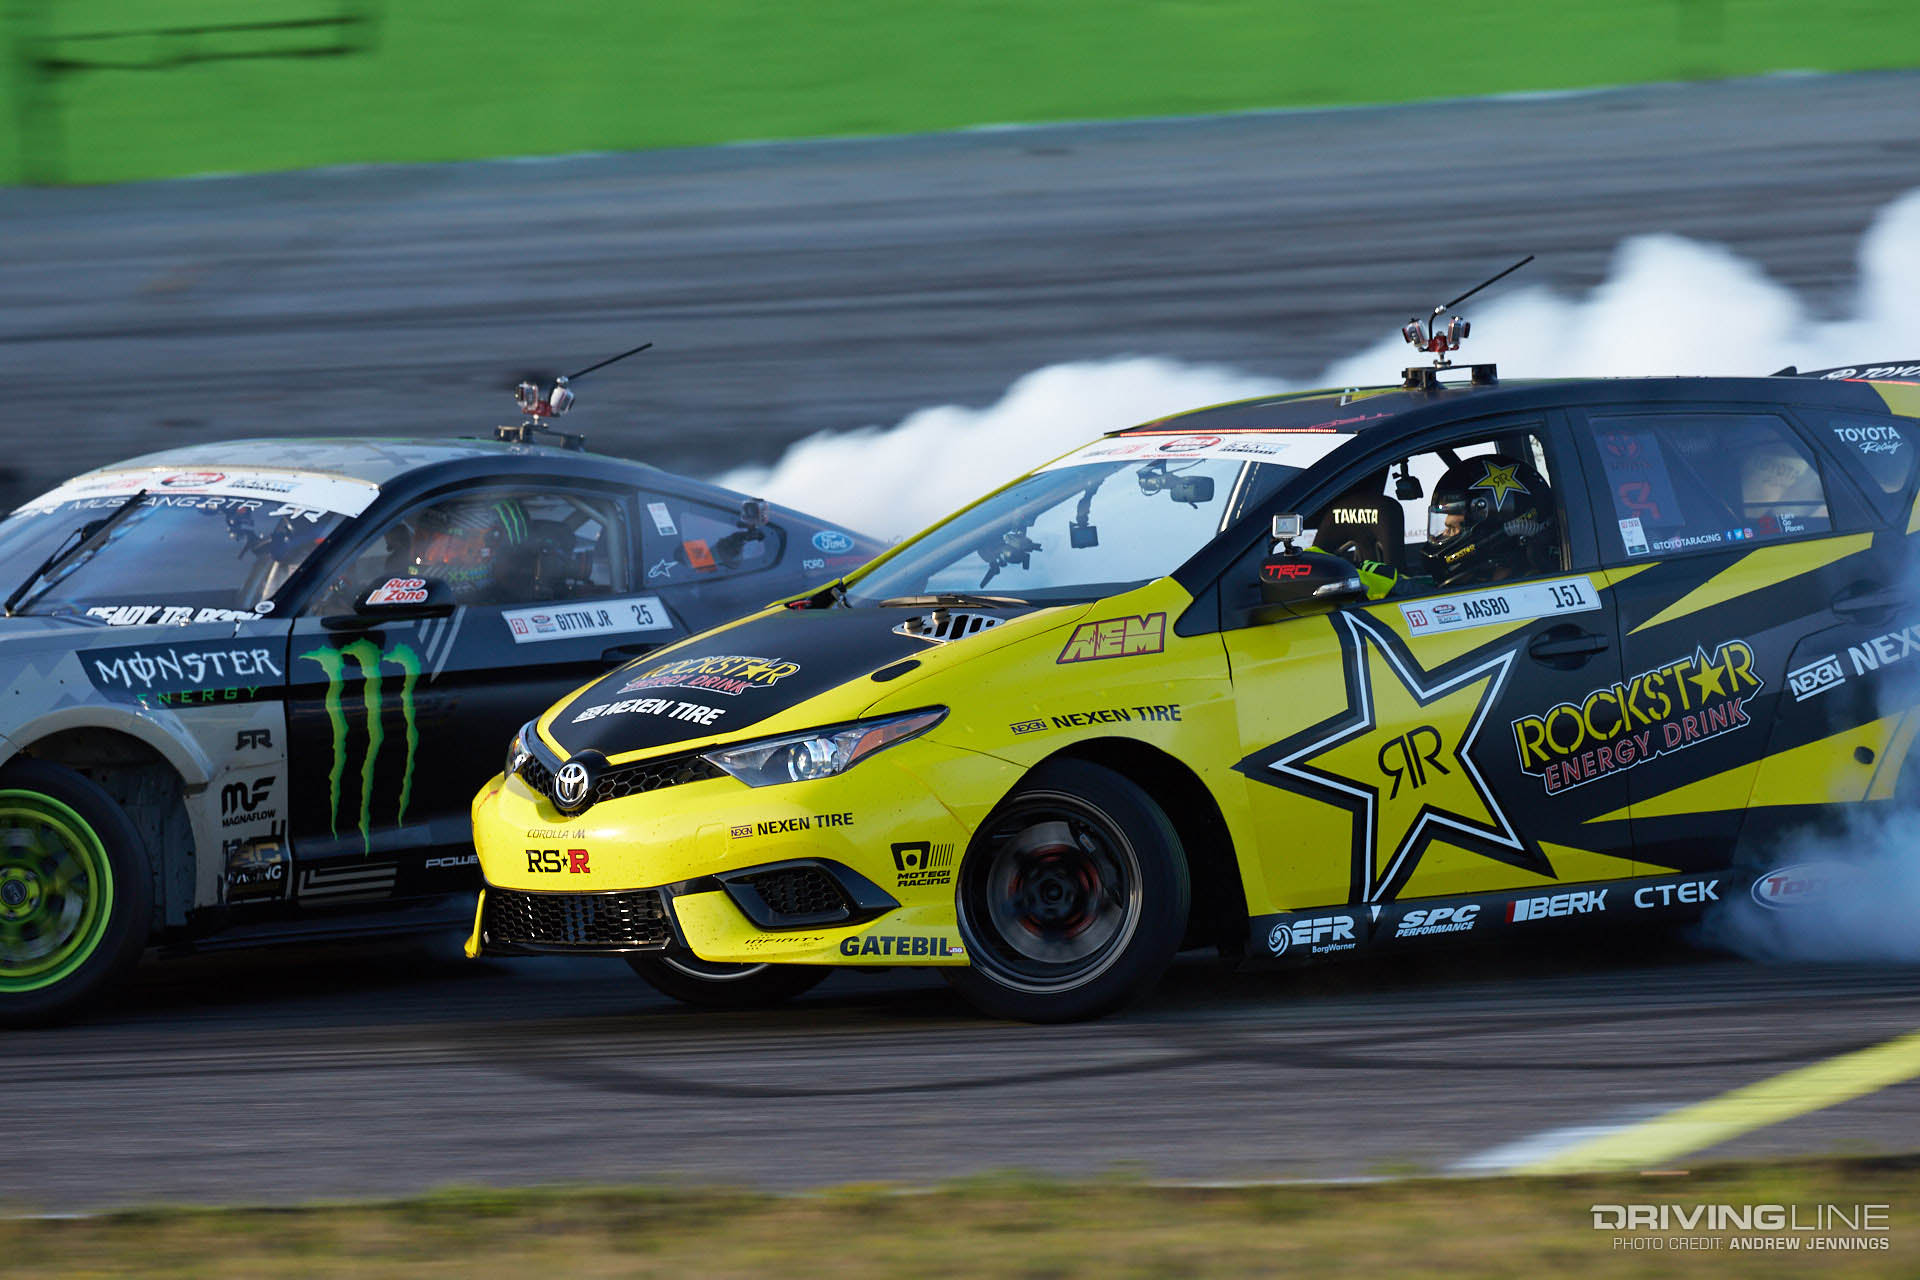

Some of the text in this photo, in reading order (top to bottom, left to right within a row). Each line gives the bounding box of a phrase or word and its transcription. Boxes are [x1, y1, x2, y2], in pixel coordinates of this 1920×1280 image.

[1833, 426, 1901, 442] TOYOTA
[1859, 440, 1903, 454] Racing
[1333, 508, 1379, 524] TAKATA
[1653, 533, 1722, 551] @TOYOTARACING
[802, 558, 825, 569] FORD
[1264, 564, 1313, 580] TRD
[385, 578, 425, 590] Auto
[384, 589, 426, 602] Zone
[1463, 596, 1510, 620] AASBO
[1549, 584, 1586, 609] 151
[555, 611, 595, 631] GITTIN
[597, 609, 613, 627] JR
[631, 604, 654, 625] 25
[1057, 612, 1166, 664] AEM
[95, 648, 282, 689] MONSTER
[1787, 656, 1845, 700] NEXEN
[136, 685, 260, 704] ENERGY
[600, 698, 669, 717] NEXEN
[669, 701, 727, 726] TIRE
[1051, 707, 1131, 729] NEXEN
[1132, 703, 1183, 722] TIRE
[1546, 697, 1747, 791] ENERGY DRINK
[221, 809, 277, 828] MAGNAFLOW
[758, 816, 811, 836] NEXEN
[814, 812, 855, 829] TIRE
[527, 828, 569, 839] COROLLA
[896, 869, 951, 880] MOTEGI
[896, 876, 951, 888] RACING
[1633, 879, 1720, 909] CTEK
[1527, 888, 1609, 920] BERK
[1398, 904, 1481, 929] SPC
[1292, 915, 1356, 945] EFR
[1394, 920, 1475, 938] PERFORMANCE
[744, 935, 825, 946] INFINITY
[1312, 942, 1356, 954] BorgWarner
